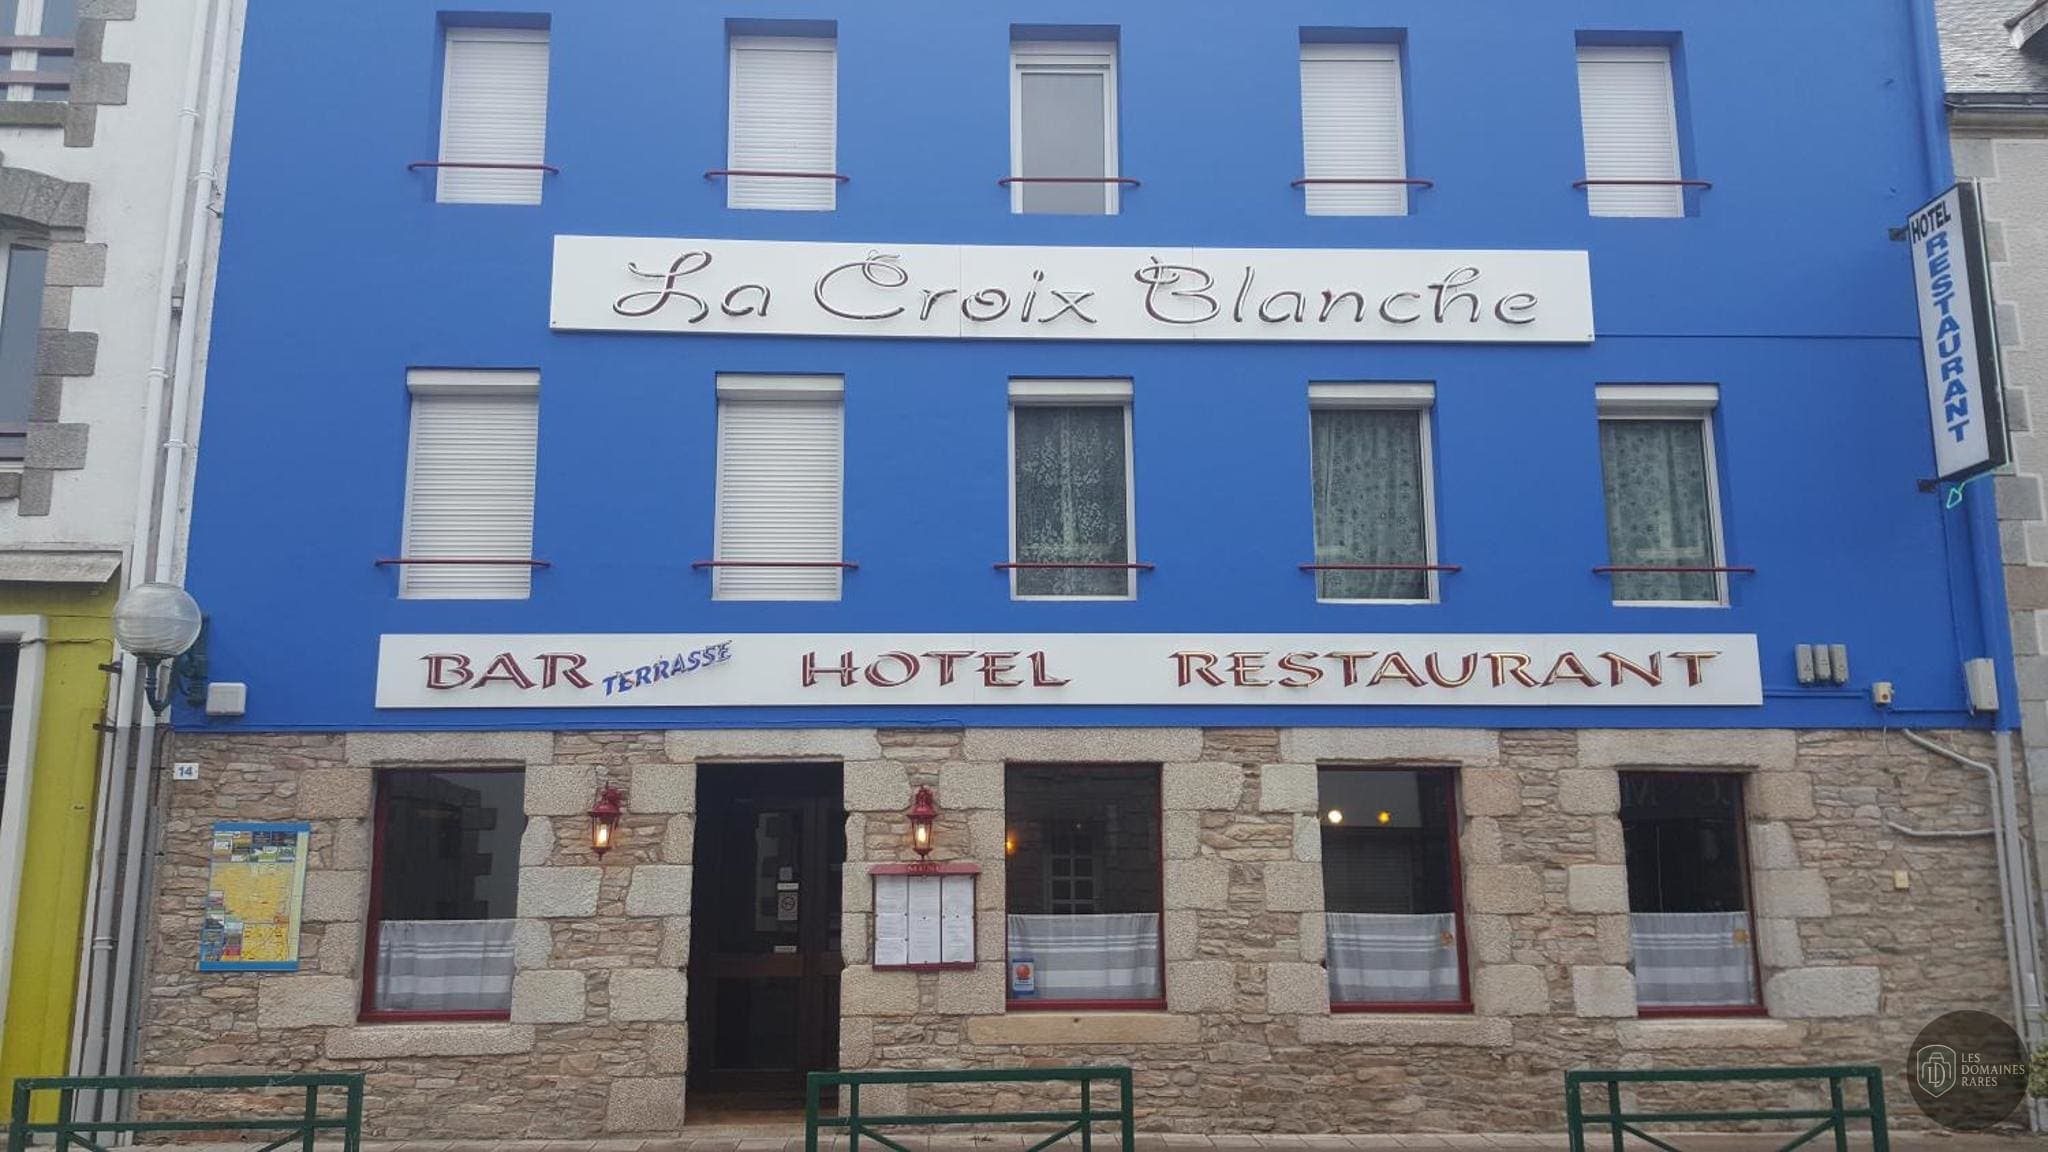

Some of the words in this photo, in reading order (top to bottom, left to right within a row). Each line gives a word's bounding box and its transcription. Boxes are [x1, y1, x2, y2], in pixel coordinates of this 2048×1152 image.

[1910, 200, 1952, 244] HOTEL
[612, 250, 771, 324] La
[814, 250, 1097, 323] Croix
[1134, 255, 1538, 325] Blanche
[1925, 231, 1970, 443] RESTAURANT
[419, 651, 594, 690] BAR
[601, 639, 733, 697] TERRASSE
[801, 649, 1071, 688] HOTEL
[1168, 650, 1723, 689] RESTAURANT
[178, 766, 193, 777] 14
